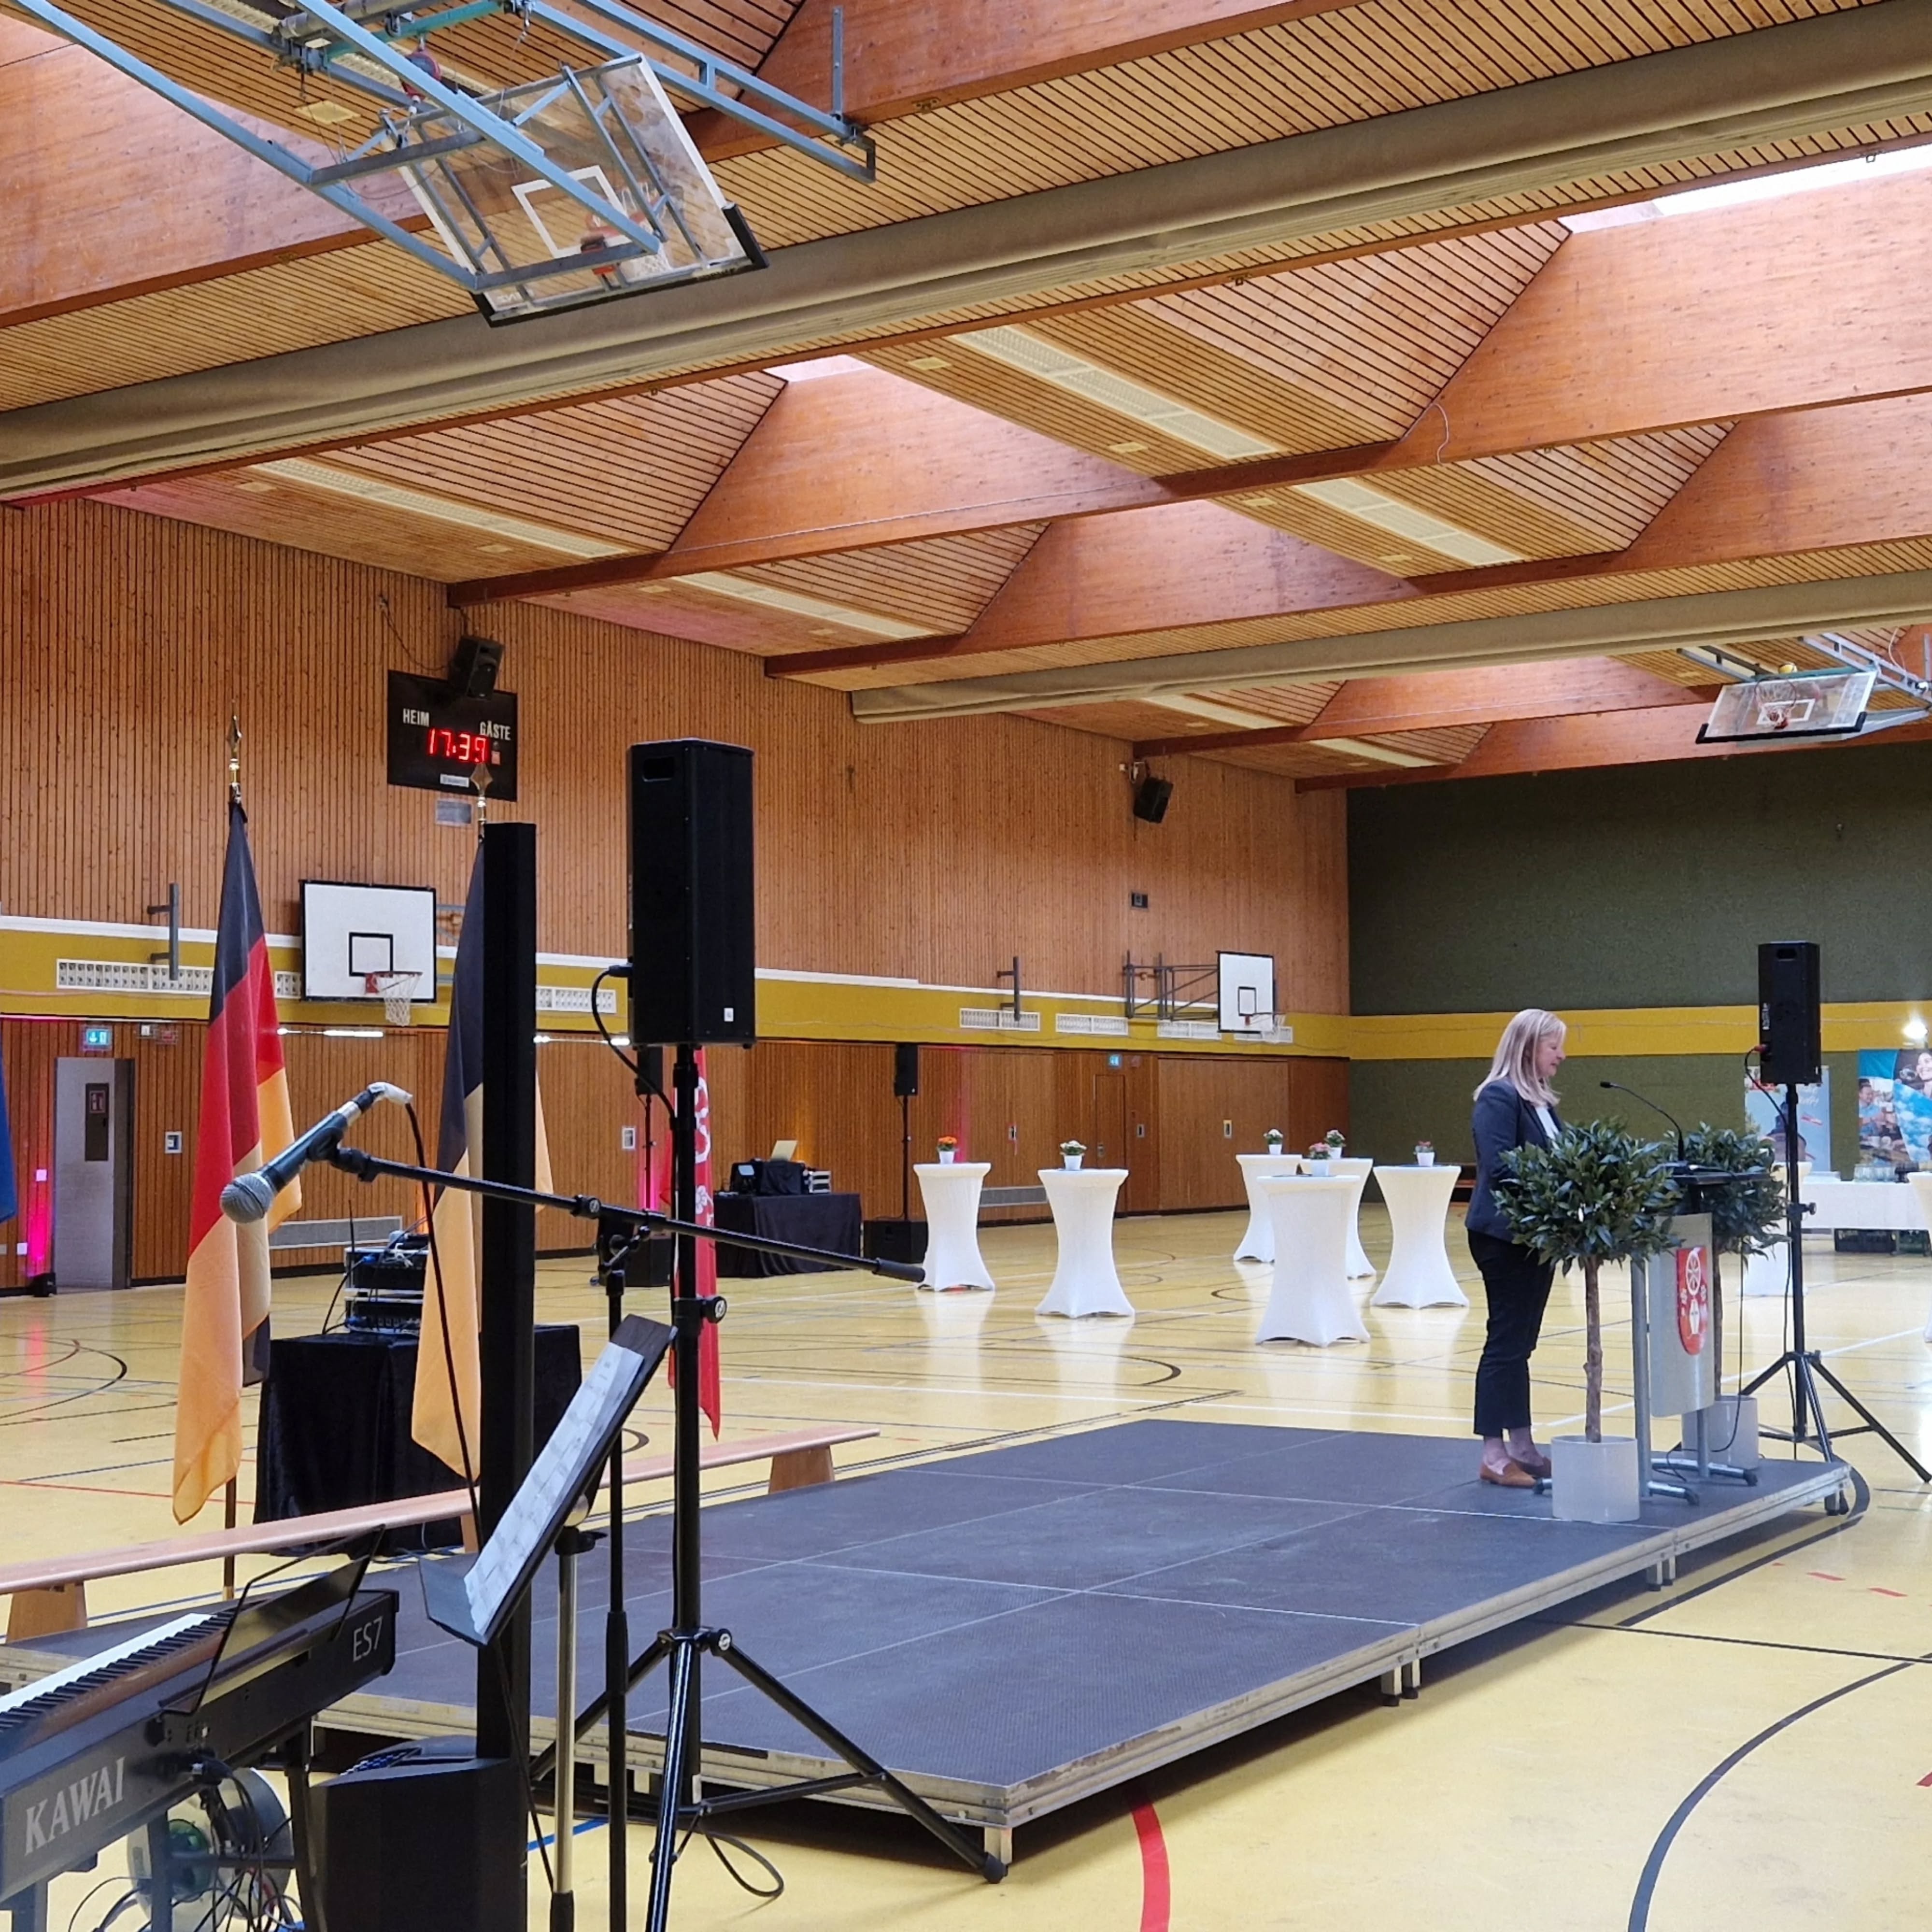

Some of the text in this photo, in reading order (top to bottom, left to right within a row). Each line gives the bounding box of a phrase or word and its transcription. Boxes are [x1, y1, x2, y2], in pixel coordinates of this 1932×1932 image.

[403, 708, 429, 726] HEIM
[479, 721, 511, 740] GÄSTE
[353, 1616, 383, 1662] ES7
[25, 1757, 125, 1856] KAWAI
